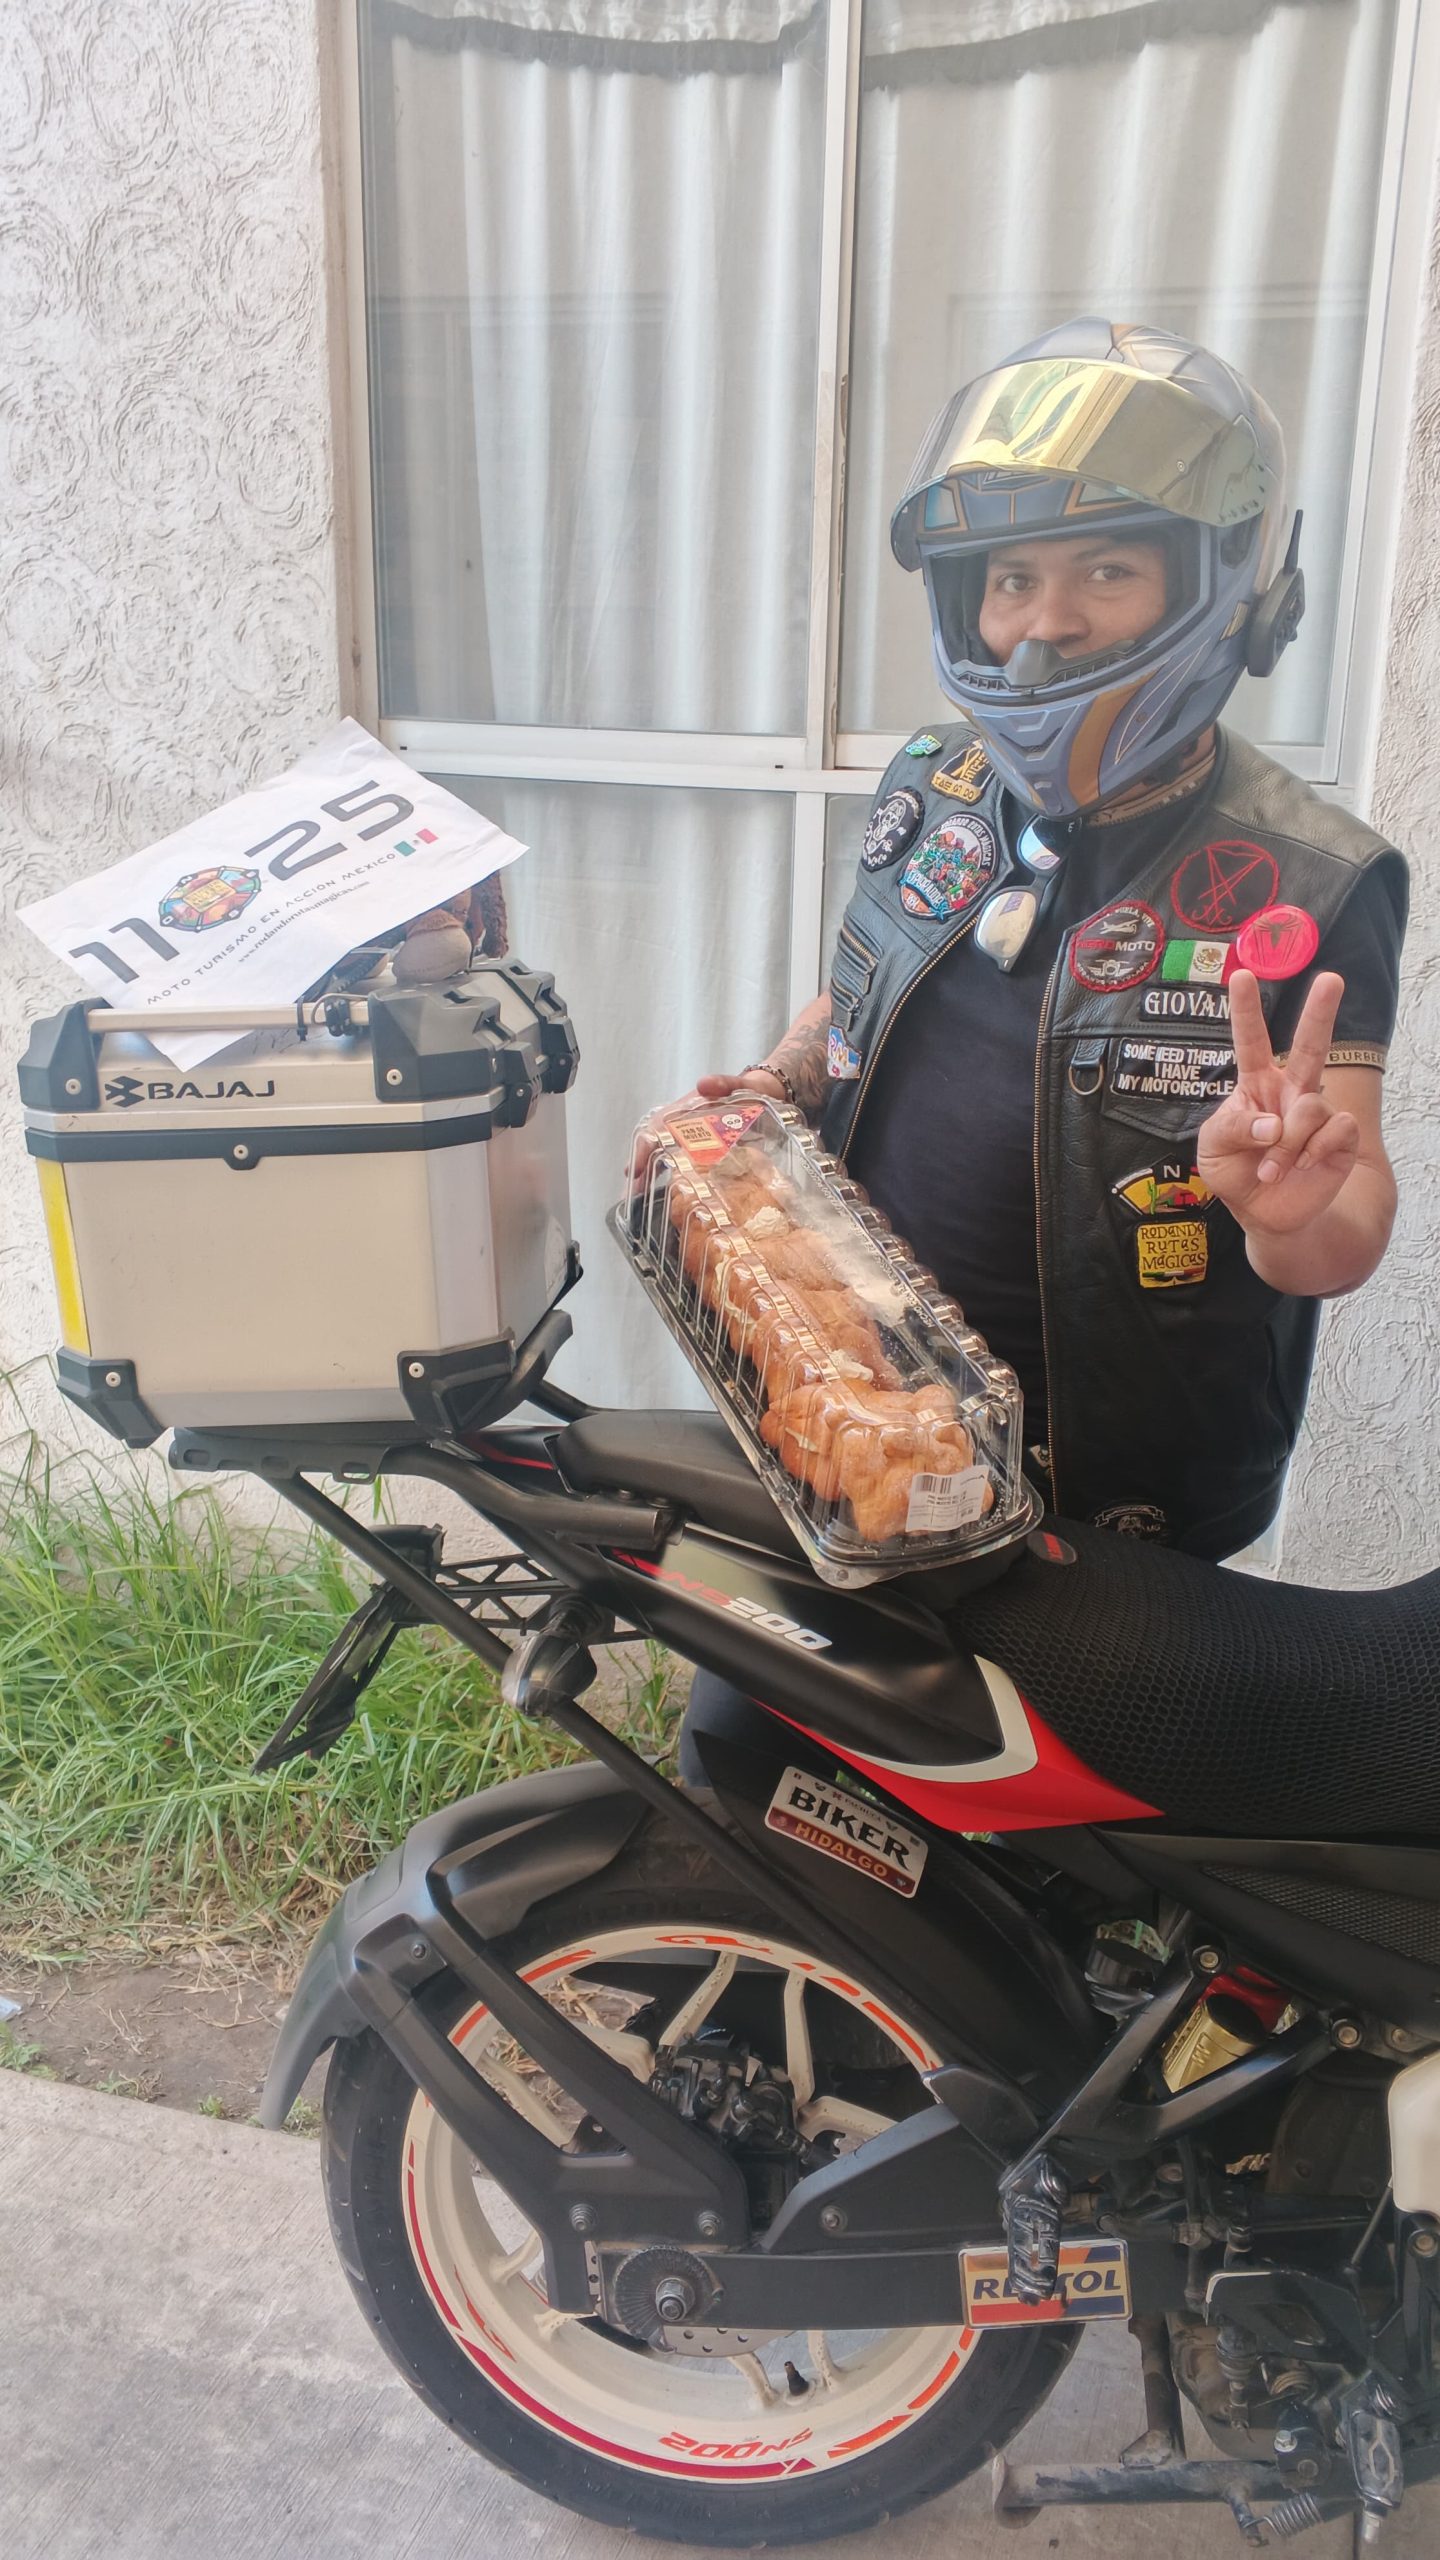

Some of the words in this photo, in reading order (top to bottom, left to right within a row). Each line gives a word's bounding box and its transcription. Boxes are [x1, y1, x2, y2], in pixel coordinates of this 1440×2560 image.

[147, 977, 191, 1005] MOTO
[194, 925, 257, 976] TURISMO
[261, 908, 280, 924] EN
[342, 852, 397, 882] MEXICO
[1115, 940, 1156, 951] MOTO
[1124, 1043, 1156, 1061] SOME
[1156, 1047, 1184, 1064] NEED
[1187, 1048, 1238, 1067] THERAPY
[1154, 1062, 1160, 1078] I
[1161, 1063, 1202, 1080] HAVE
[147, 1080, 275, 1100] BAJAJ
[1118, 1073, 1141, 1091] MY
[1140, 1076, 1235, 1098] MOTORCYCLE
[1163, 1164, 1181, 1179] N
[788, 1786, 911, 1872] BIKER
[795, 1823, 888, 1878] HIDALGO
[973, 2269, 1122, 2300] RESOL
[659, 2428, 813, 2459] 200NS
